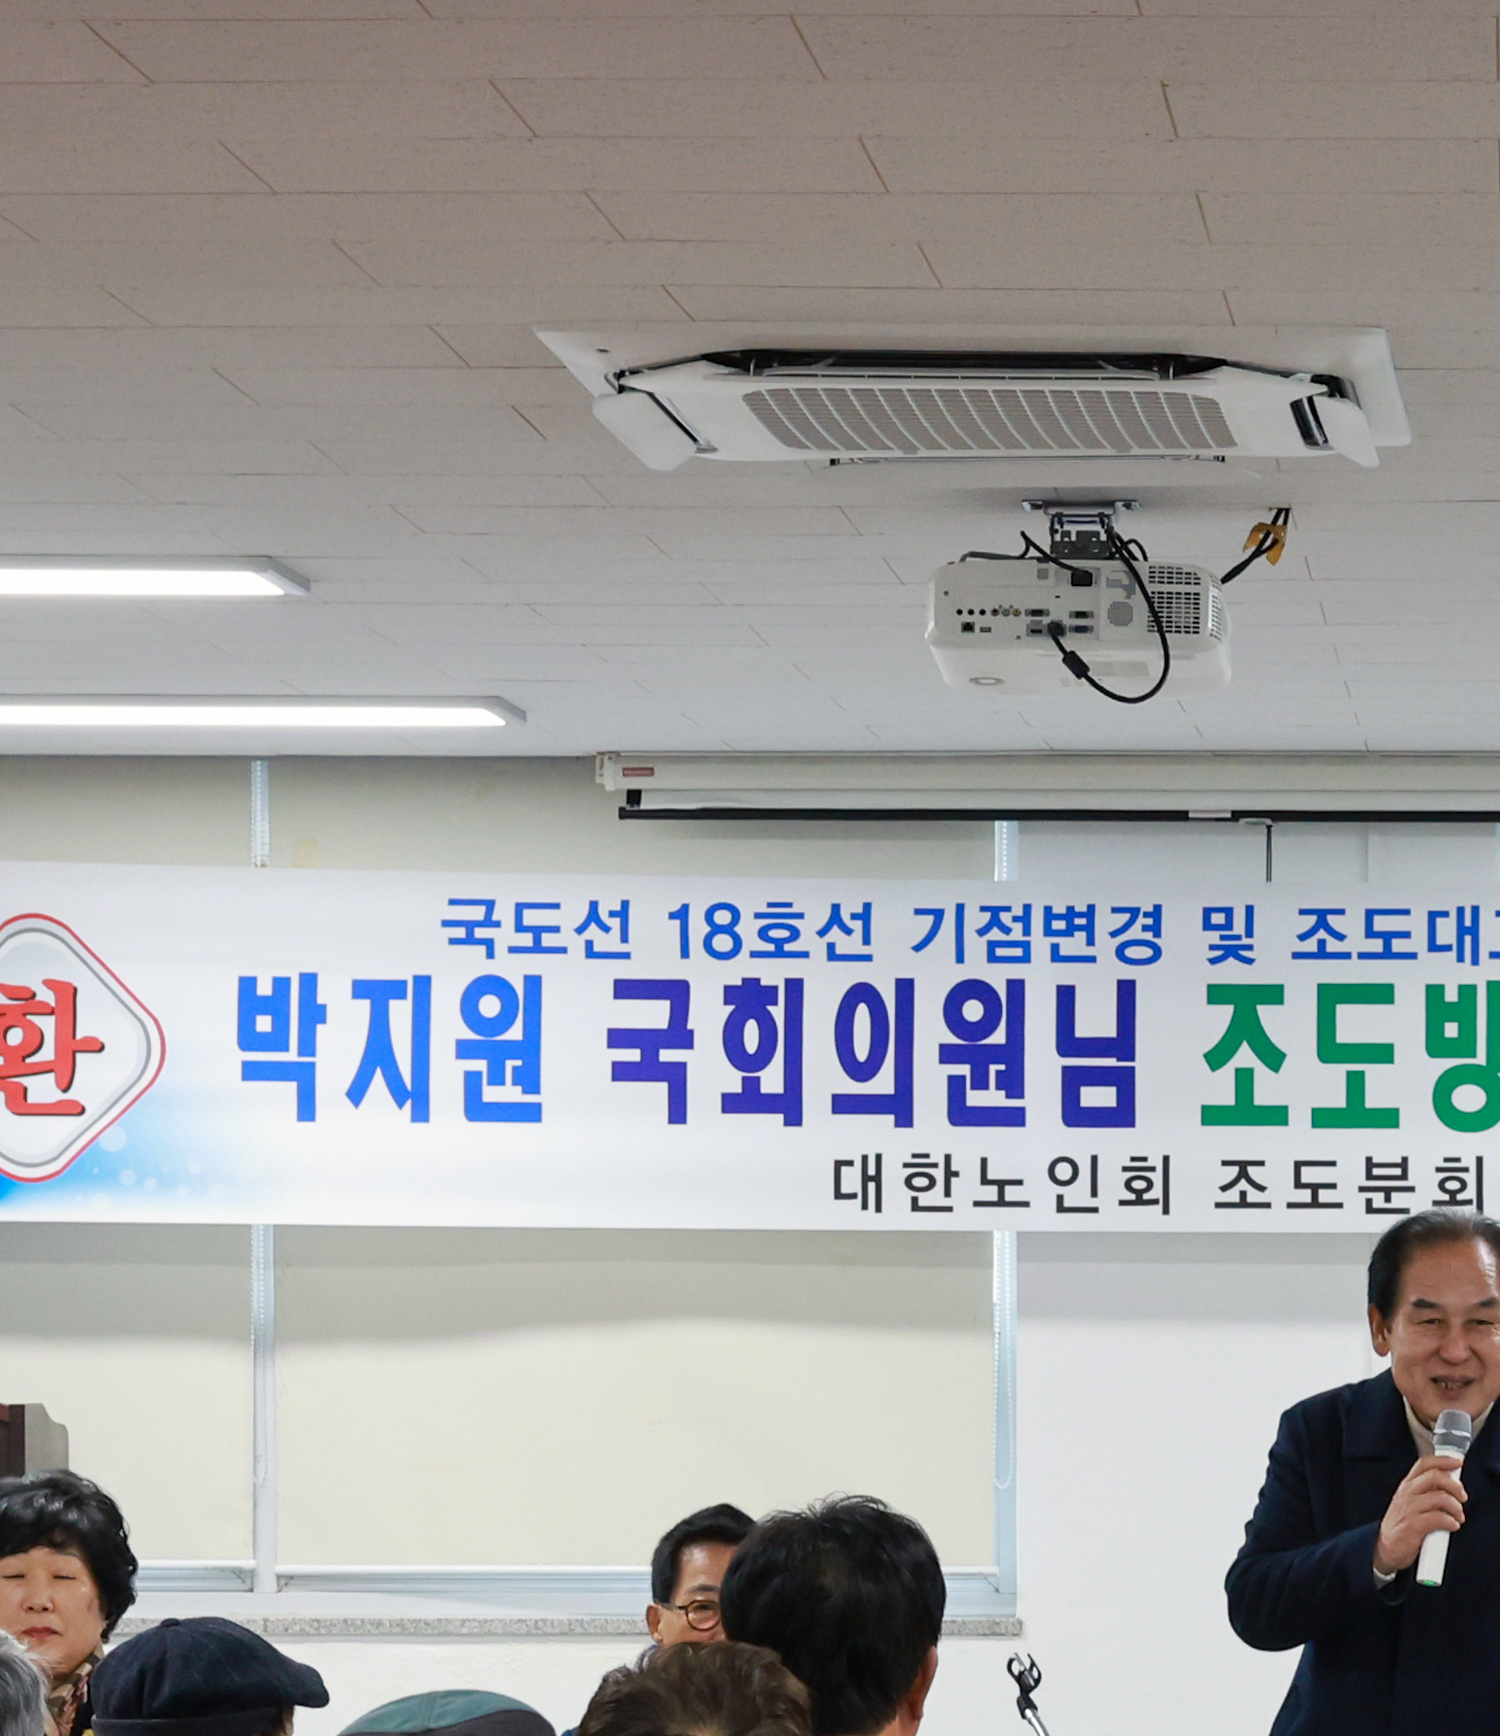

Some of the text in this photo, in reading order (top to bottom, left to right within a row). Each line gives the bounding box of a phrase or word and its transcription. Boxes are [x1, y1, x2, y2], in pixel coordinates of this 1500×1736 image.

[440, 898, 632, 960] 국도선
[668, 900, 874, 963] 18호선
[910, 902, 1164, 967] 기점변경
[1201, 904, 1257, 966] 및
[236, 972, 544, 1124] 박지원
[606, 977, 1138, 1130] 국회의원님
[833, 1152, 1484, 1216] 대한노인회 조도분회
